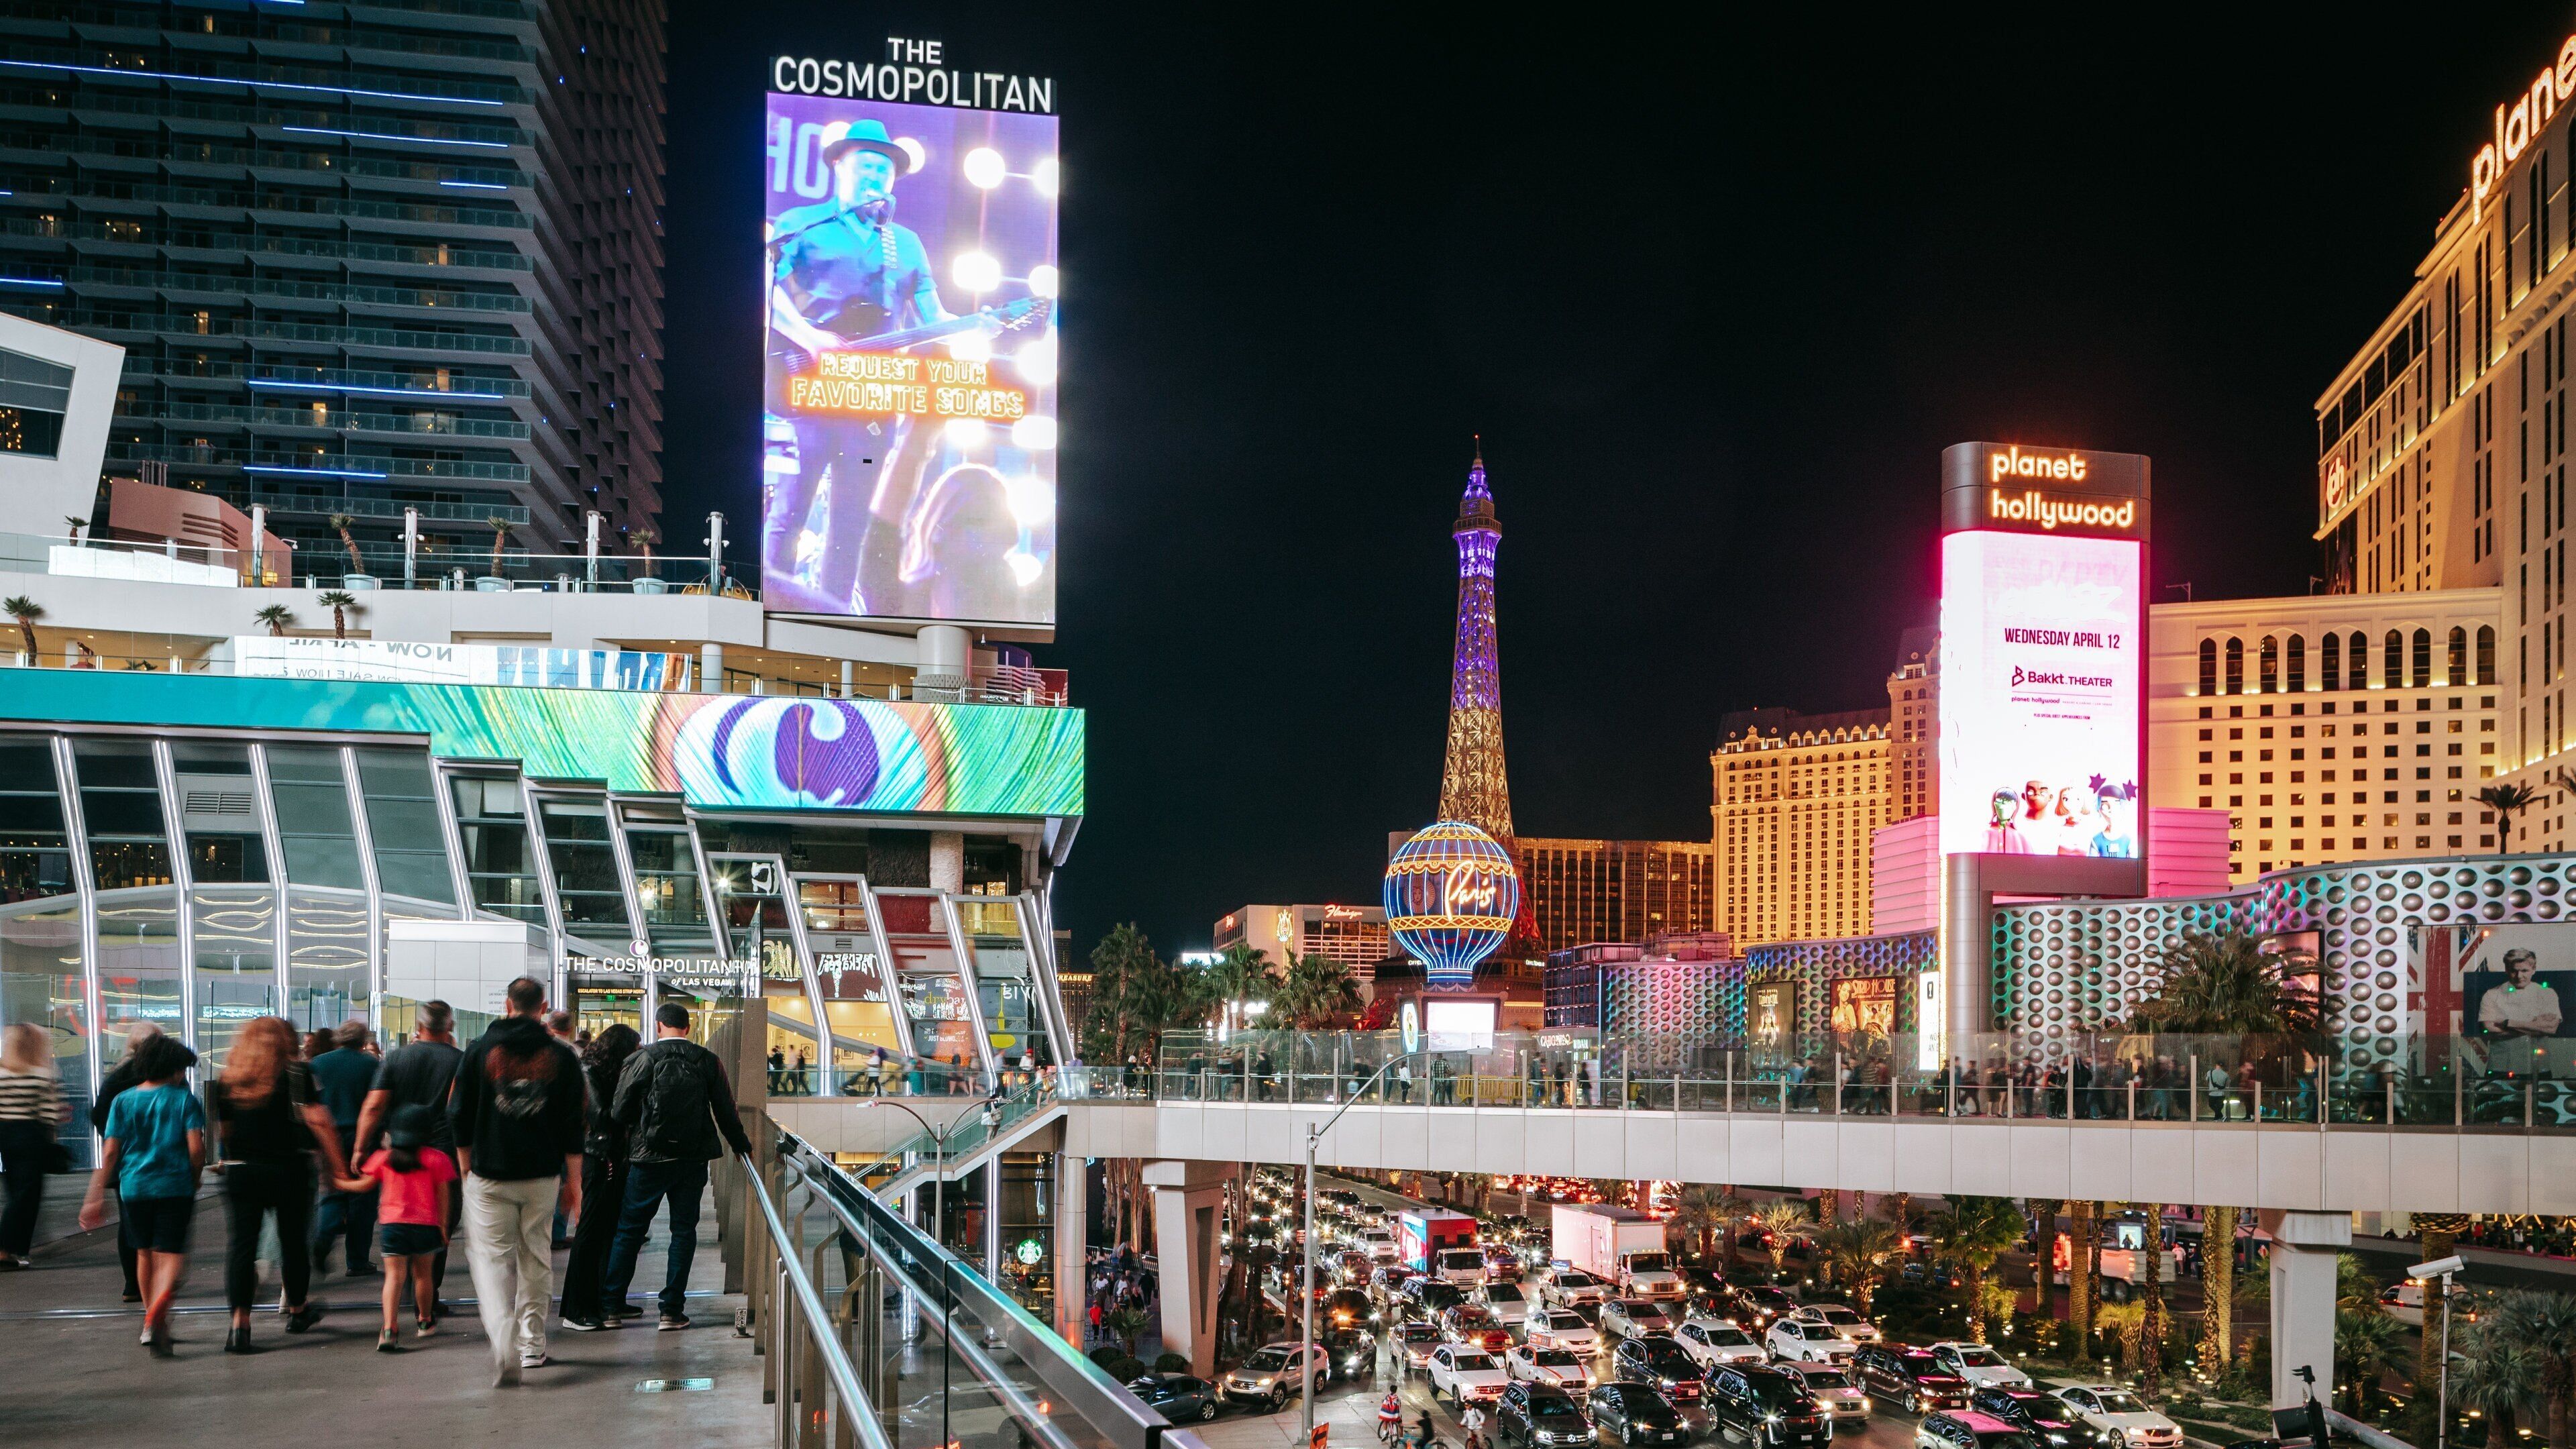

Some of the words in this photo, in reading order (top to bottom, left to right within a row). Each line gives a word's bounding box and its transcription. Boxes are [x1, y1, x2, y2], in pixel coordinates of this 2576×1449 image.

[888, 37, 942, 64] THE
[774, 56, 1052, 113] COSMOPOLITAN
[820, 352, 919, 381] REQUEST
[926, 359, 987, 385] YOUR
[792, 378, 927, 413] FAVORITE
[936, 387, 1024, 419] SONGS
[1992, 445, 2086, 482] planet
[1992, 489, 2134, 529] hollywood
[2004, 627, 2070, 646] WEDNESDAY
[2073, 632, 2104, 648] APRIL
[2108, 634, 2121, 649] 12
[2028, 671, 2065, 684] Bakkt
[2068, 676, 2112, 687] THEATER
[1444, 860, 1497, 922] Paris
[1324, 904, 1363, 920] Flamingo
[564, 957, 597, 971] THE
[603, 957, 729, 975] COSMOPOLITAN
[671, 977, 682, 986] of
[682, 977, 700, 986] LAS
